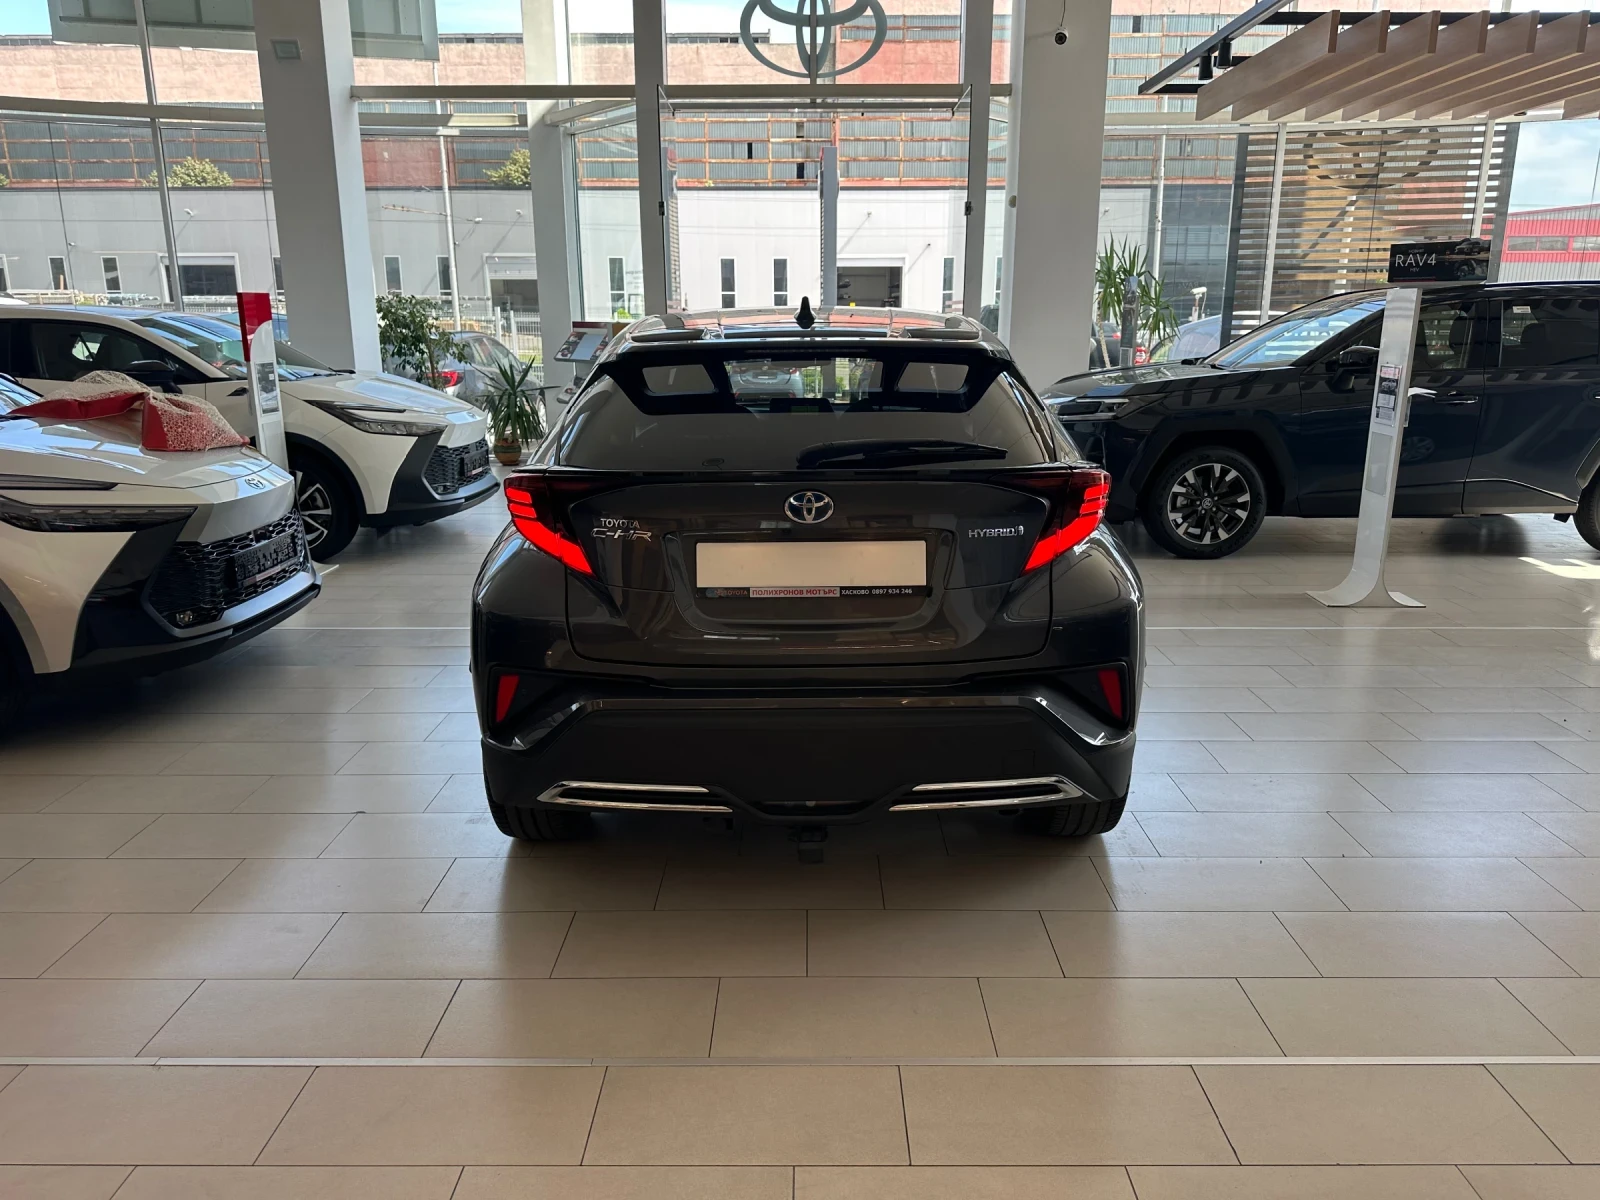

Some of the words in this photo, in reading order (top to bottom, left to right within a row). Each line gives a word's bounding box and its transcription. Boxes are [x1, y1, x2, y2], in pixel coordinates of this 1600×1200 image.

[1395, 253, 1436, 267] RAV4
[600, 518, 641, 528] TOYOTA
[591, 528, 653, 542] C-HR
[968, 528, 1014, 537] HYBRID
